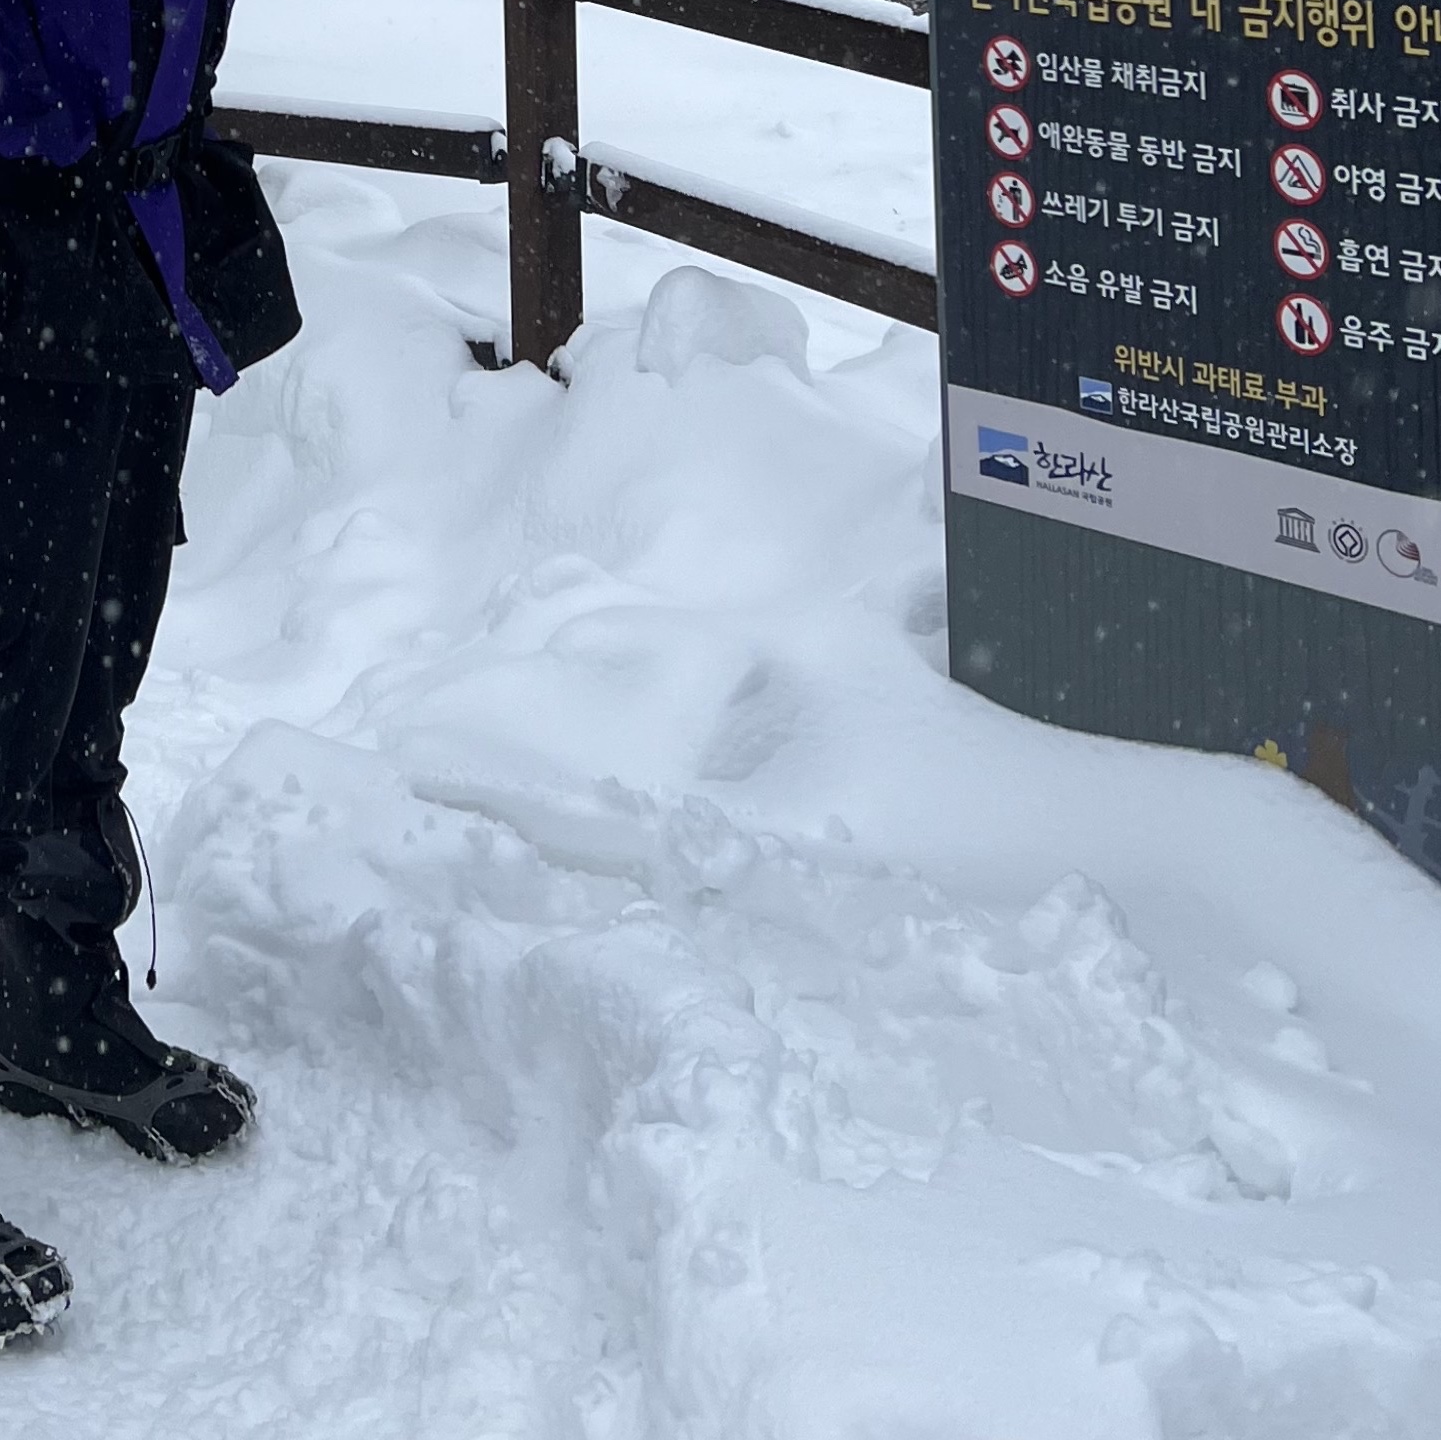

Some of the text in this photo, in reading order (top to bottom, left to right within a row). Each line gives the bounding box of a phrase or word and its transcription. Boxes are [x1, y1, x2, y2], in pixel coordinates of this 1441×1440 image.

[1036, 52, 1206, 101] 임산물 채취금지
[1331, 87, 1386, 123] 취사
[1038, 121, 1241, 178] 애완동물 동반 금지
[1333, 164, 1386, 202] 야영
[1041, 190, 1219, 247] 쓰레기 투기 금지
[1336, 238, 1390, 277] 흡연
[1044, 260, 1197, 315] 소음 유발 금지
[1339, 315, 1395, 353] 음주
[1114, 344, 1328, 417] 위반시 과태료 부과
[1117, 387, 1358, 466] 한라산국립공원관리소장
[1036, 480, 1080, 499] HALLASAN
